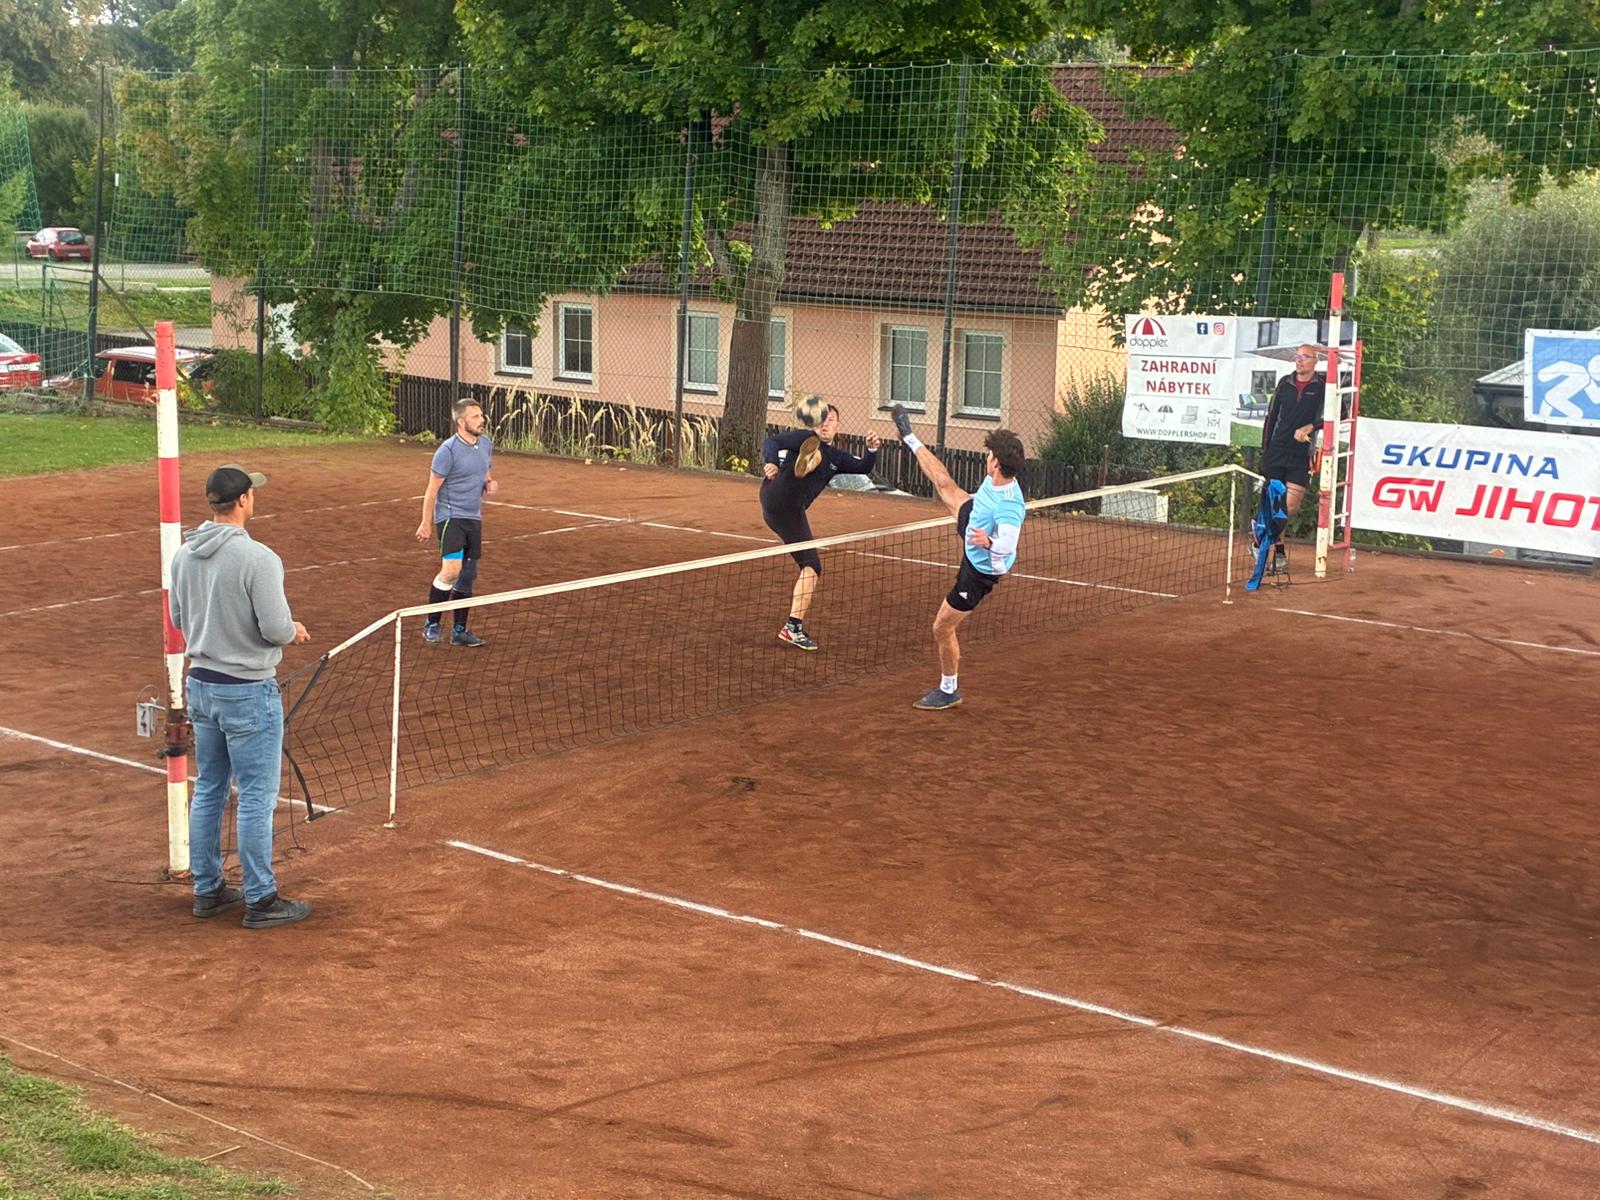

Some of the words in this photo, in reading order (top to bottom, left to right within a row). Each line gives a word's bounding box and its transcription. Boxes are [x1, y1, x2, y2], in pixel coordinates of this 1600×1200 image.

[1141, 359, 1217, 375] ZAHRADNÍ
[1146, 377, 1212, 395] NÁBYTEK
[1136, 427, 1217, 440] WWW.DOPPLERSHOP.CZ
[1381, 443, 1560, 480] SKUPINA
[1372, 476, 1446, 513] GW
